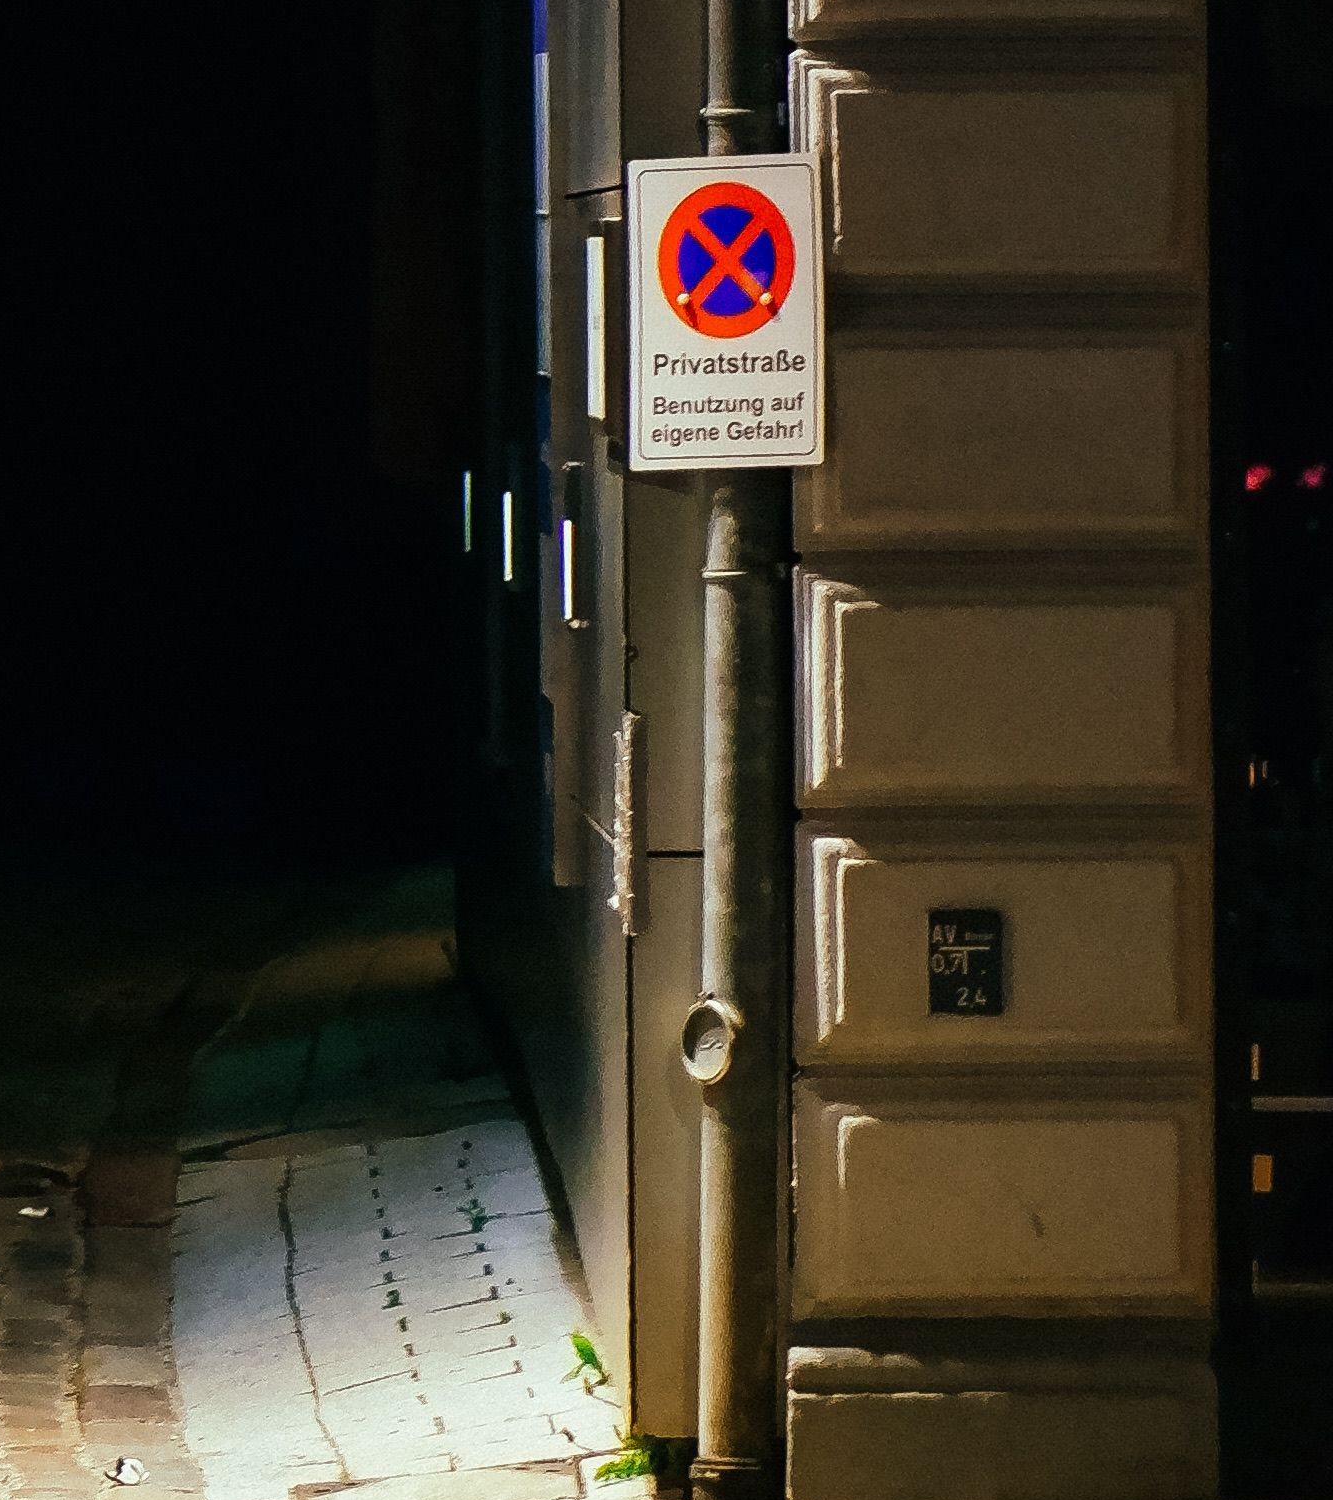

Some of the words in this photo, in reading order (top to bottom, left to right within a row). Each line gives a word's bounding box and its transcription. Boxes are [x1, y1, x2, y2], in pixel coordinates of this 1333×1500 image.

[653, 349, 806, 376] Privatstraße
[652, 394, 765, 417] Benutzung
[771, 391, 806, 412] auf
[651, 425, 720, 448] eigene
[726, 419, 804, 441] Gefahr!
